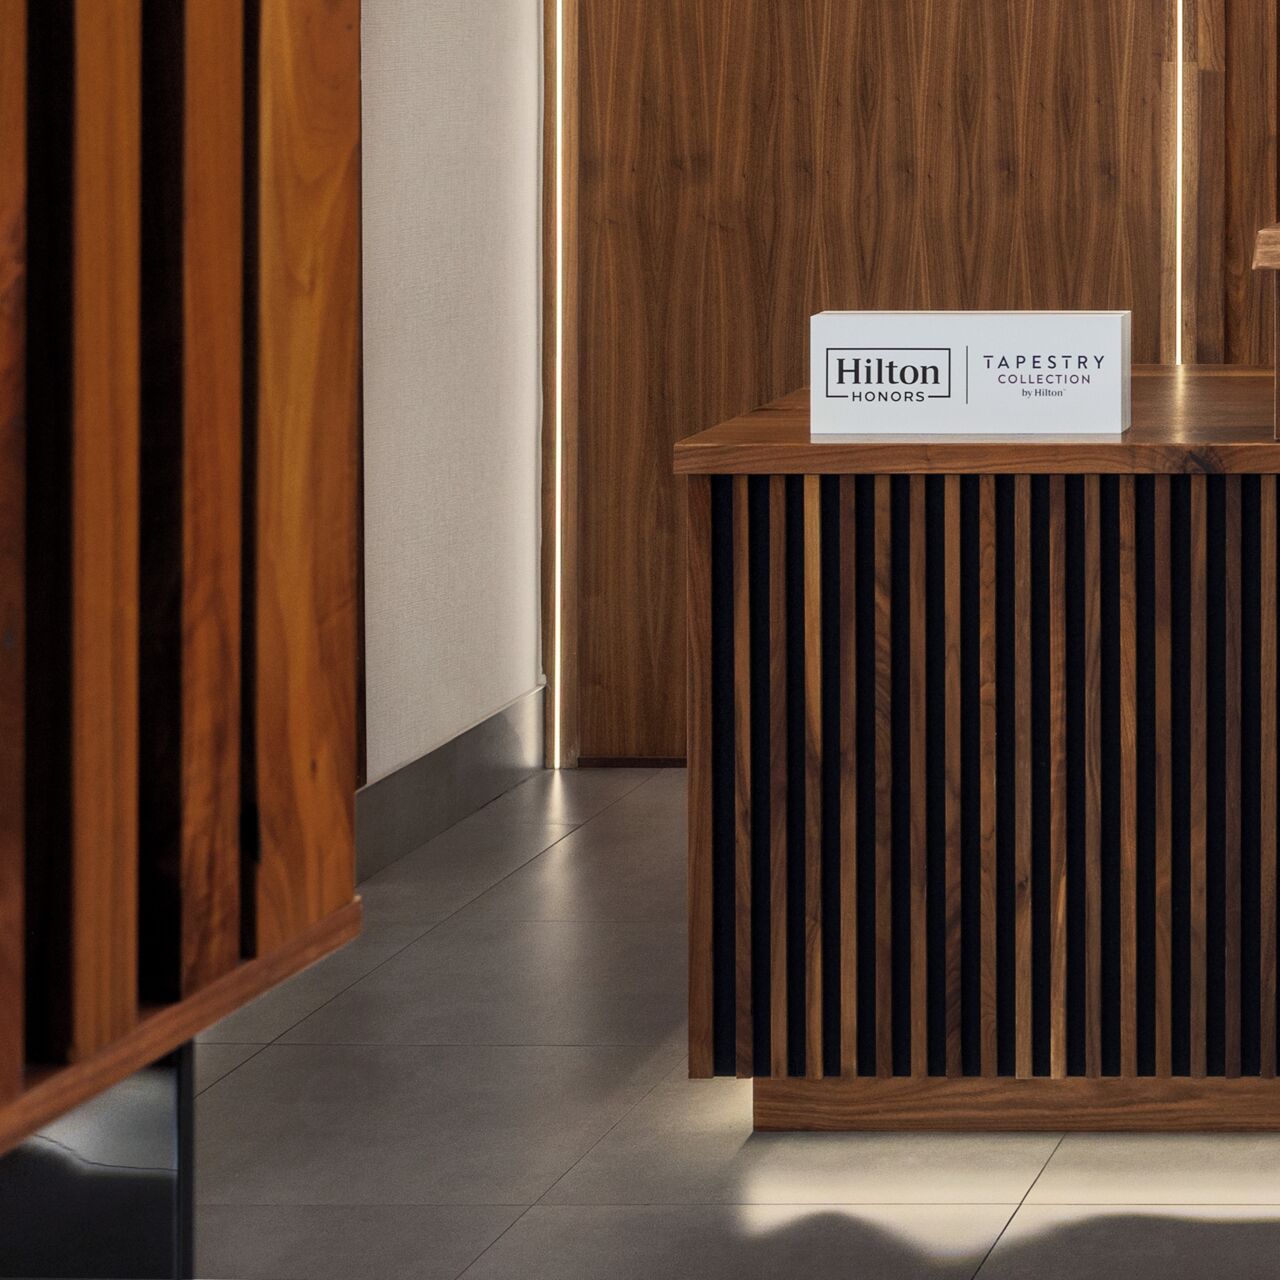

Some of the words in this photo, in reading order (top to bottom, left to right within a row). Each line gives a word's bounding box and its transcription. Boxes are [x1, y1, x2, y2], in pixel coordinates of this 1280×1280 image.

[982, 355, 1105, 369] TAPESTRY
[836, 358, 941, 385] Hilton
[997, 374, 1091, 385] COLLECTION
[851, 391, 926, 403] HONORS
[1021, 388, 1033, 399] by
[1034, 388, 1064, 397] Hilton
